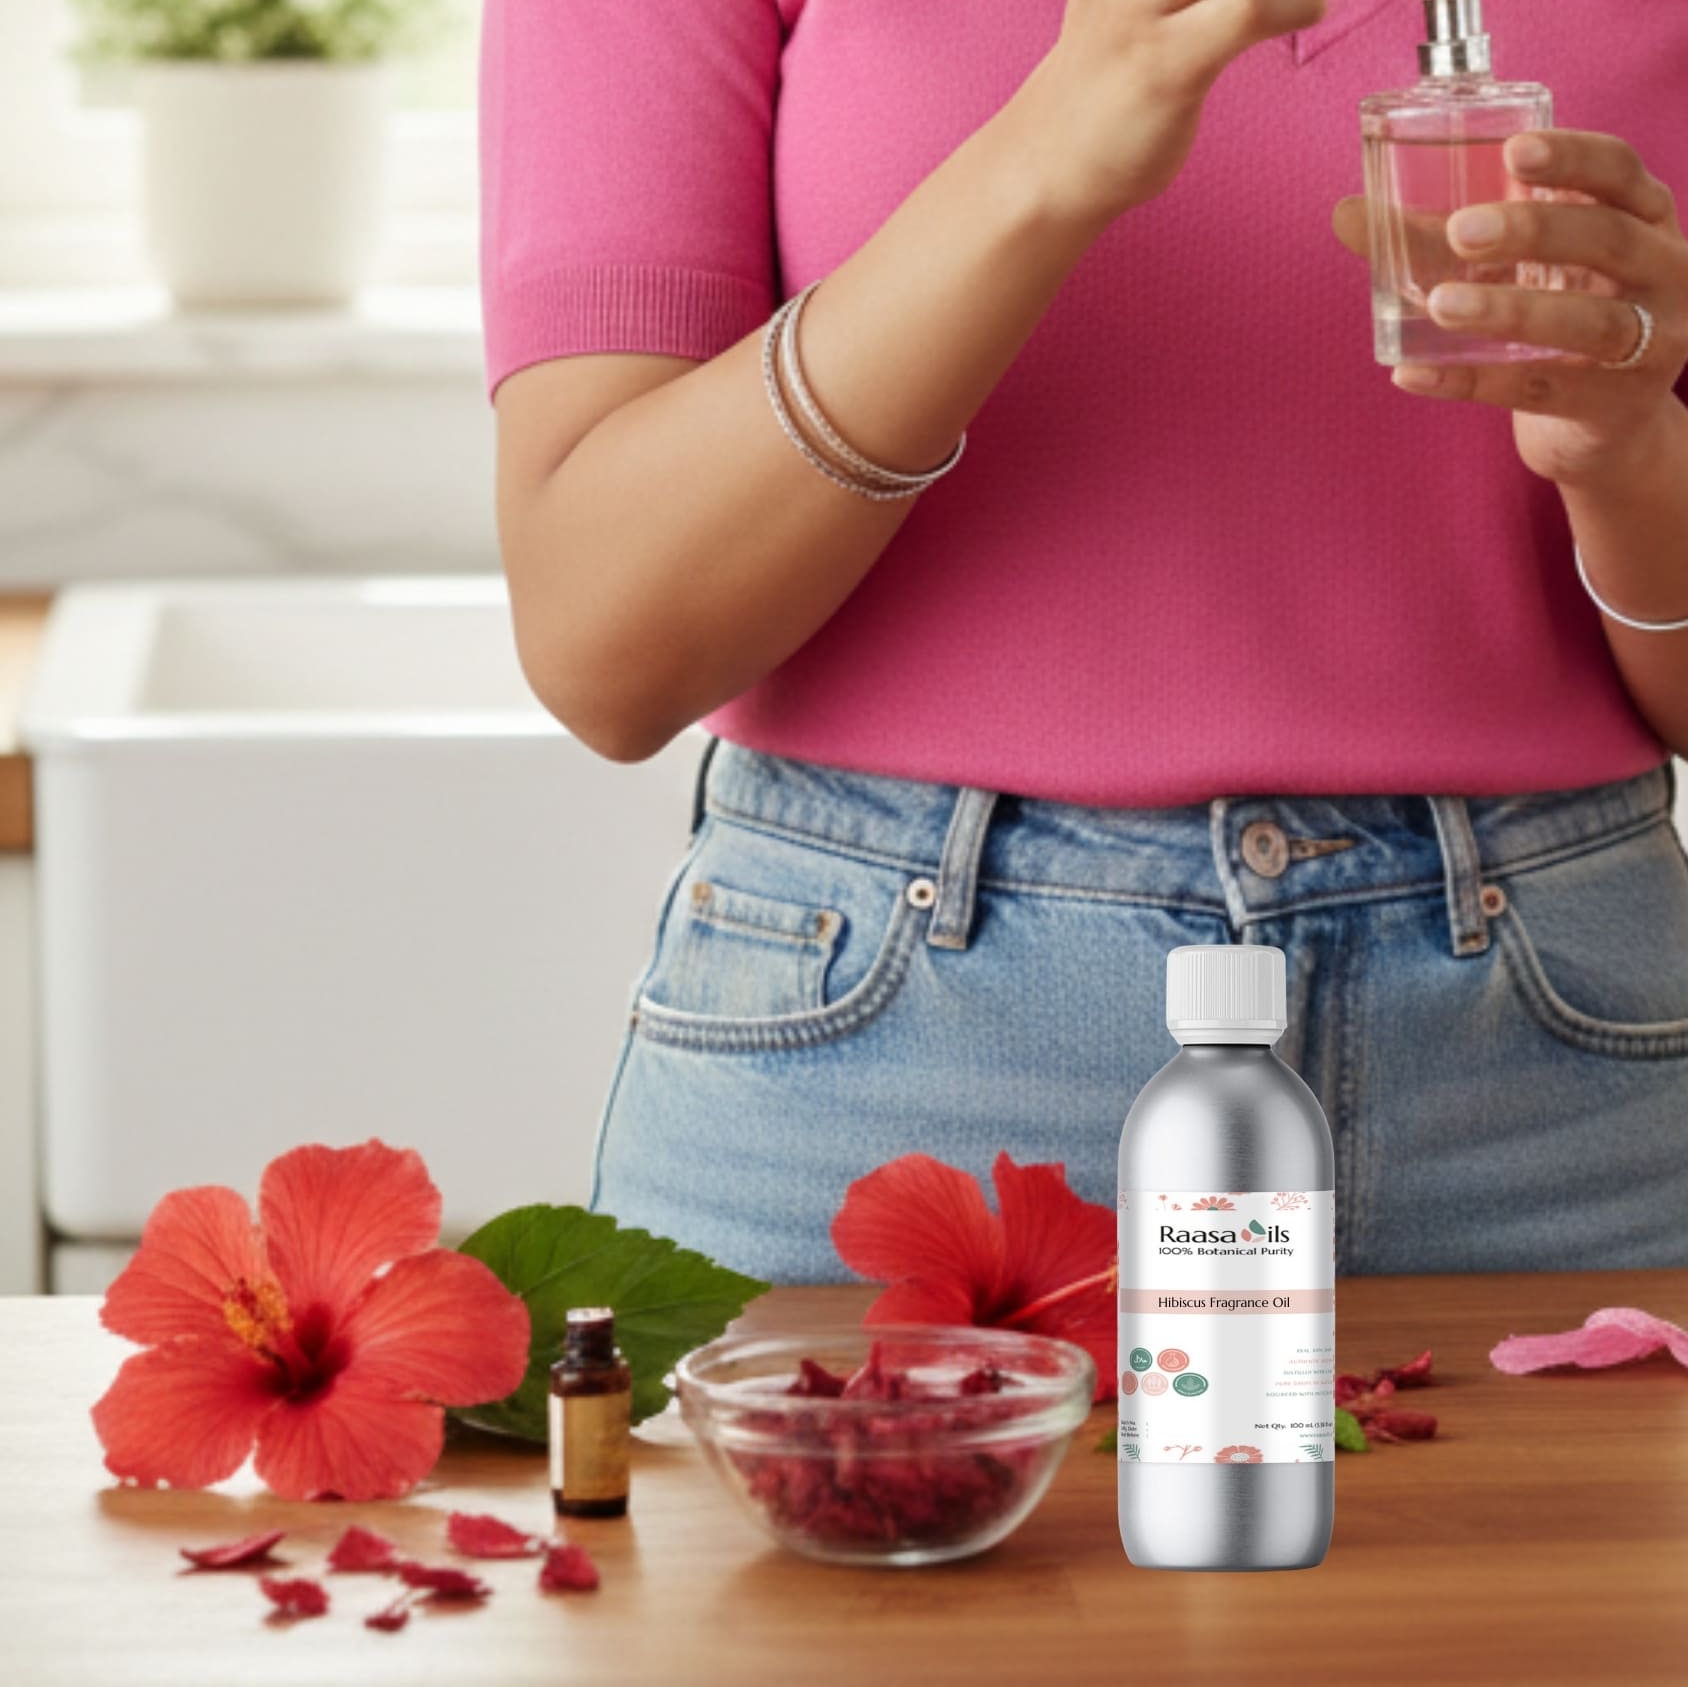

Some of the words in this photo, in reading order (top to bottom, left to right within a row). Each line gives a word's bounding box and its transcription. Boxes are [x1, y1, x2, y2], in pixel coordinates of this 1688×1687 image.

[1159, 1225, 1236, 1243] Raasa
[1158, 1246, 1193, 1256] 100%
[1197, 1246, 1257, 1256] Botanical
[1261, 1246, 1294, 1257] Purity
[1158, 1296, 1206, 1309] Hibiscus
[1210, 1296, 1269, 1311] Fragrance
[1273, 1296, 1290, 1309] Oil
